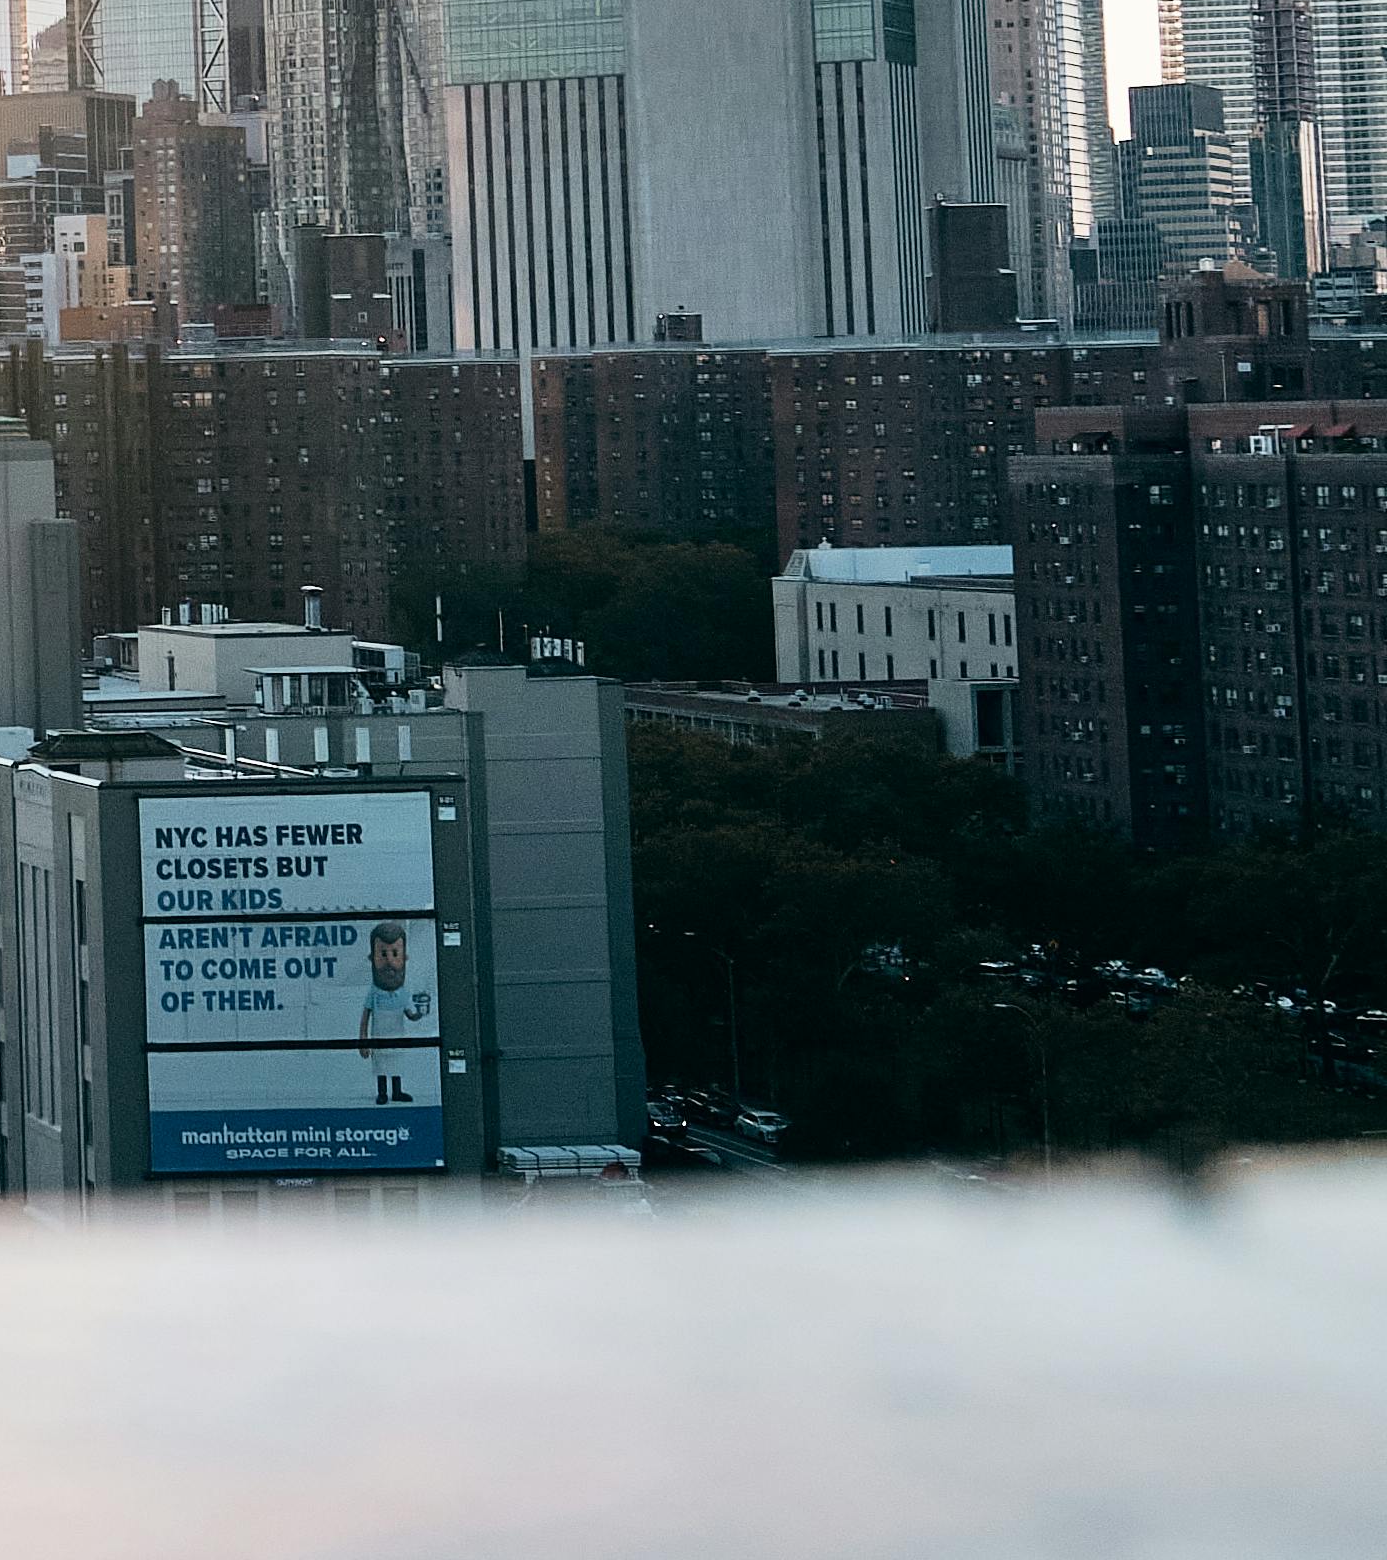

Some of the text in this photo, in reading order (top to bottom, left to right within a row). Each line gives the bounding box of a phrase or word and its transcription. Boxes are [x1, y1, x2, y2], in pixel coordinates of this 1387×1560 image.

[155, 823, 363, 849] NYC HAS FEWER
[156, 855, 328, 881] CLOSETS BUT
[157, 887, 283, 911] OUR KIDS
[158, 925, 358, 950] AREN'T AFRAID
[159, 956, 338, 981] TO COME OUT
[160, 989, 284, 1013] OF THEM.
[181, 1122, 411, 1146] manhattan mini storage
[226, 1147, 289, 1159] SPACE
[294, 1147, 332, 1158] FOR
